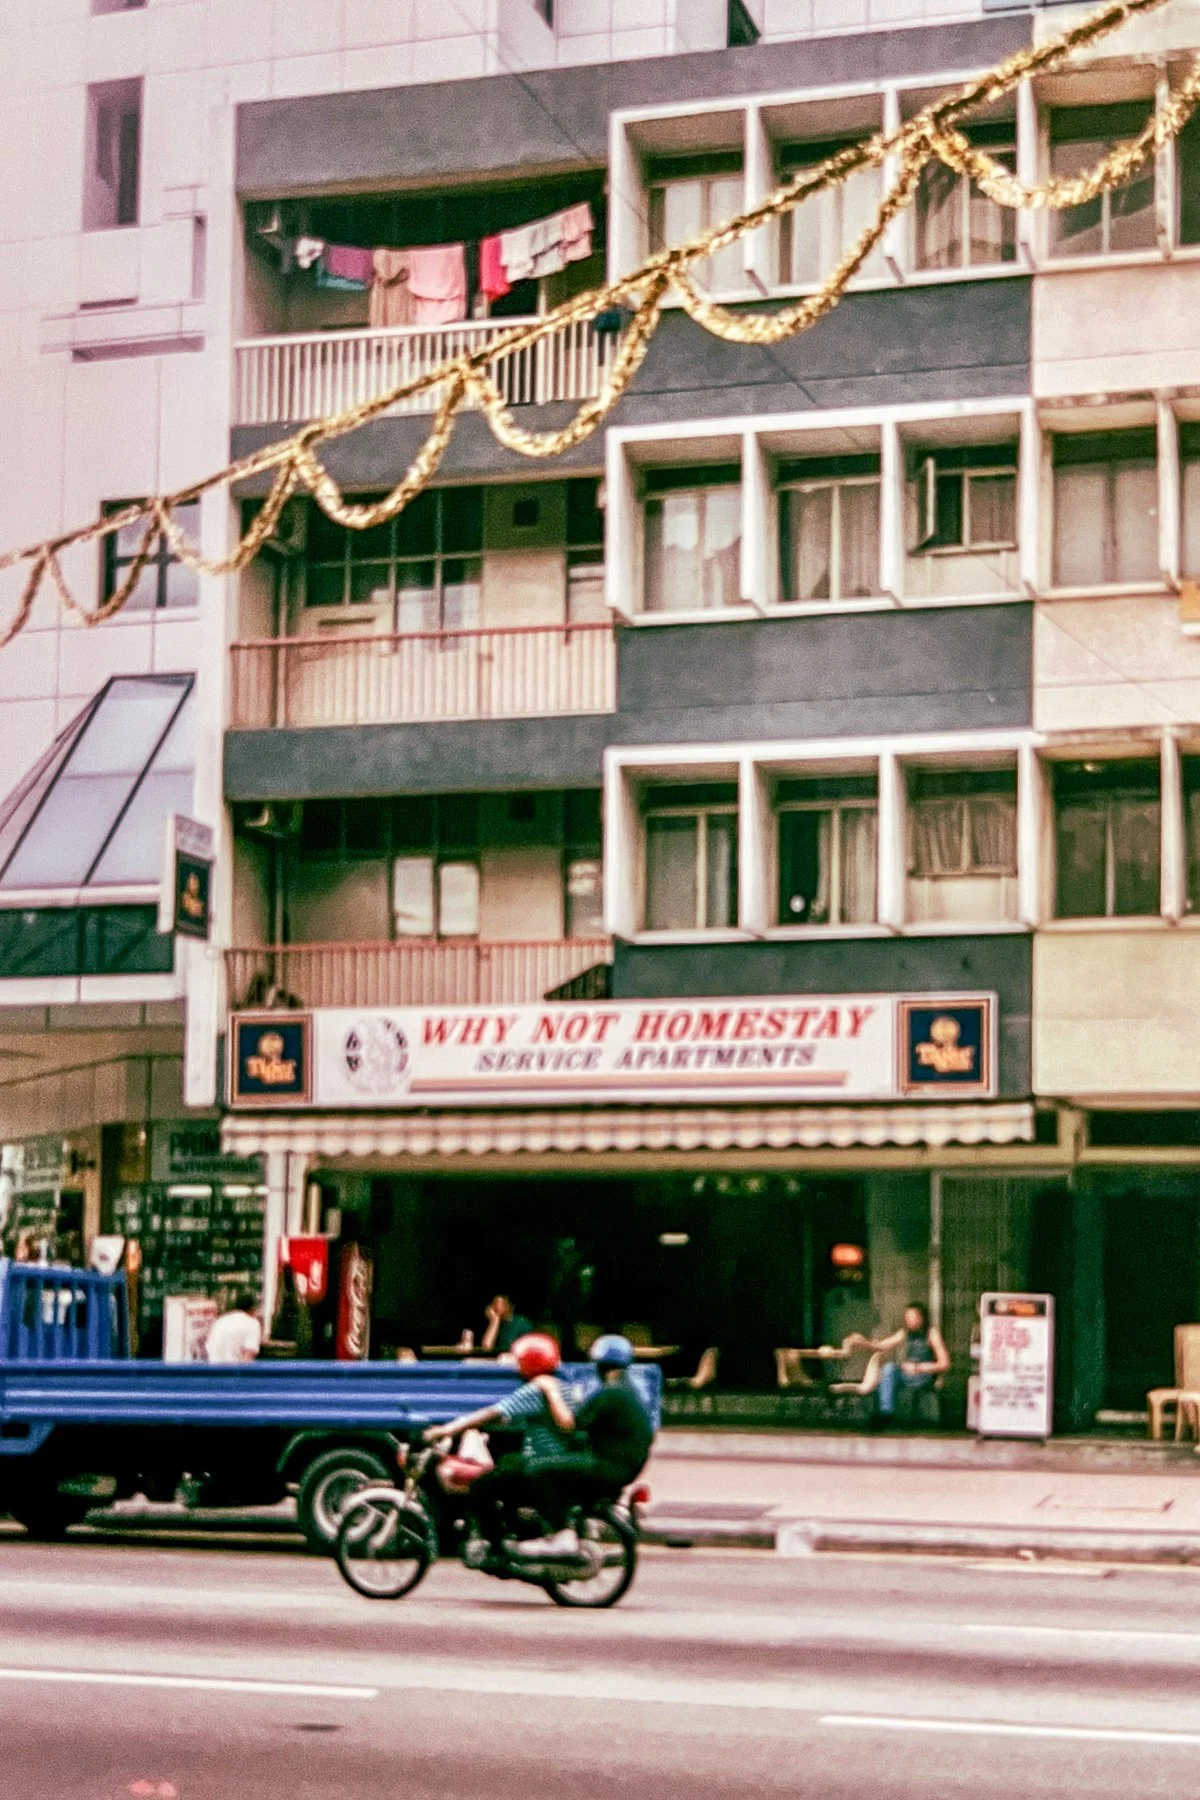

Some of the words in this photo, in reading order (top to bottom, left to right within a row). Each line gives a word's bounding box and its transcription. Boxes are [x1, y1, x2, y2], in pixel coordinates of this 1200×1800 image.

[423, 1014, 520, 1045] WHY
[531, 1012, 621, 1044] NOT
[633, 1005, 875, 1042] HOMESTAY
[476, 1048, 603, 1071] SERVICE
[613, 1043, 816, 1070] APARTMENTS
